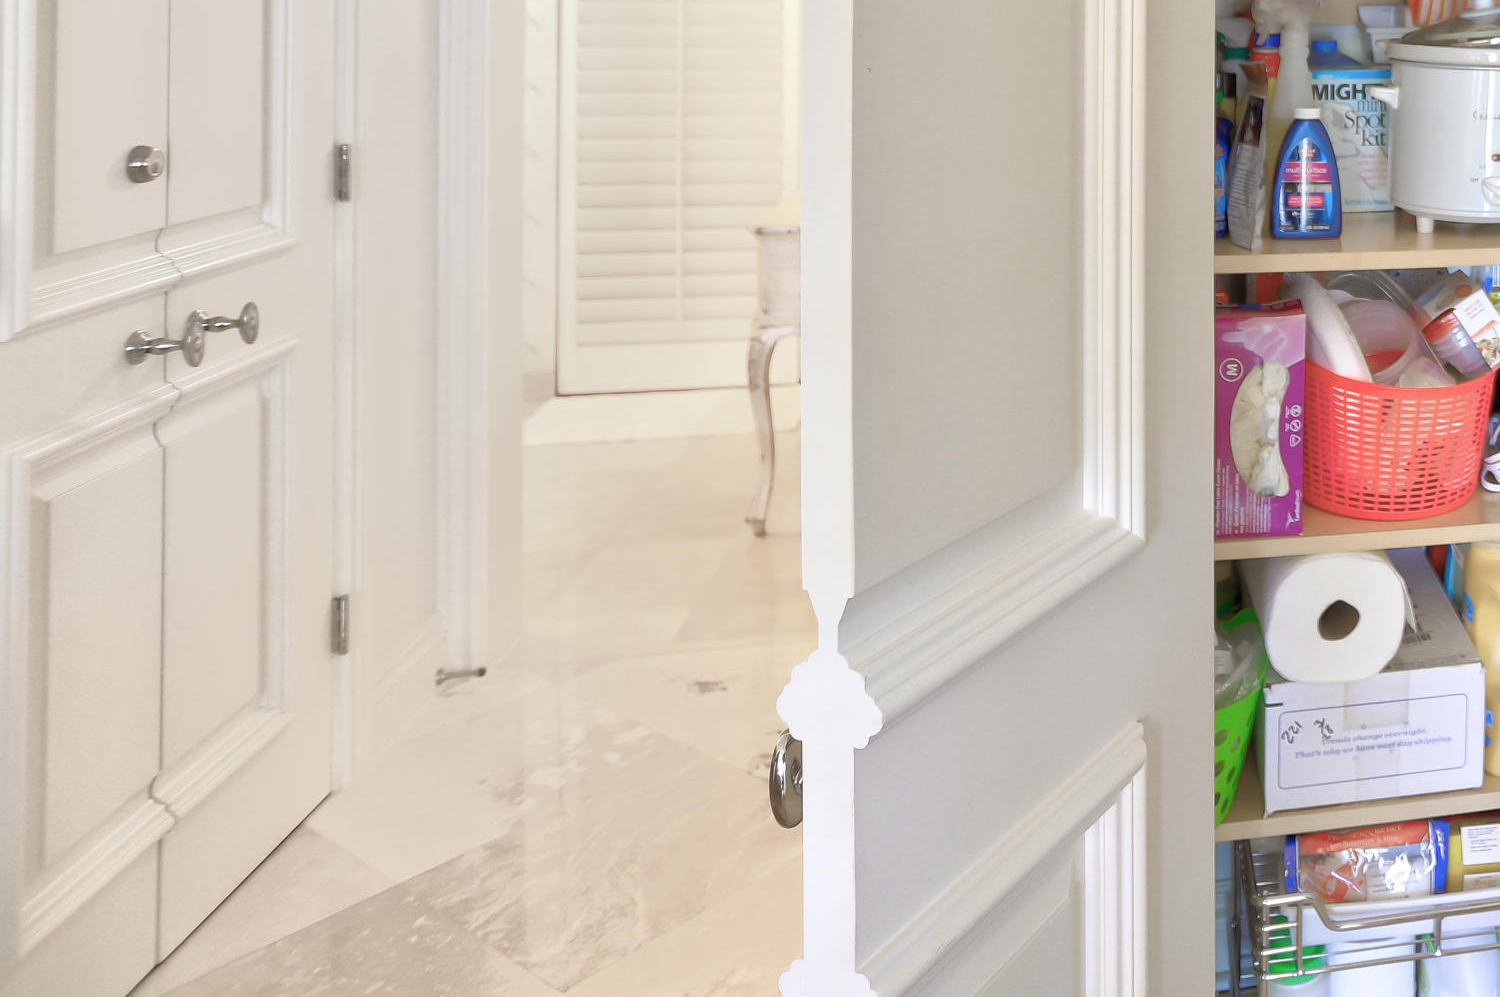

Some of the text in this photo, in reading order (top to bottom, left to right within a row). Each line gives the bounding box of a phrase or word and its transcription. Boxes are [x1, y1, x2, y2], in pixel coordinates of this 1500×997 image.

[1344, 110, 1386, 135] Spot
[1361, 129, 1386, 147] kit
[1281, 720, 1302, 744] 221
[1355, 743, 1375, 752] have
